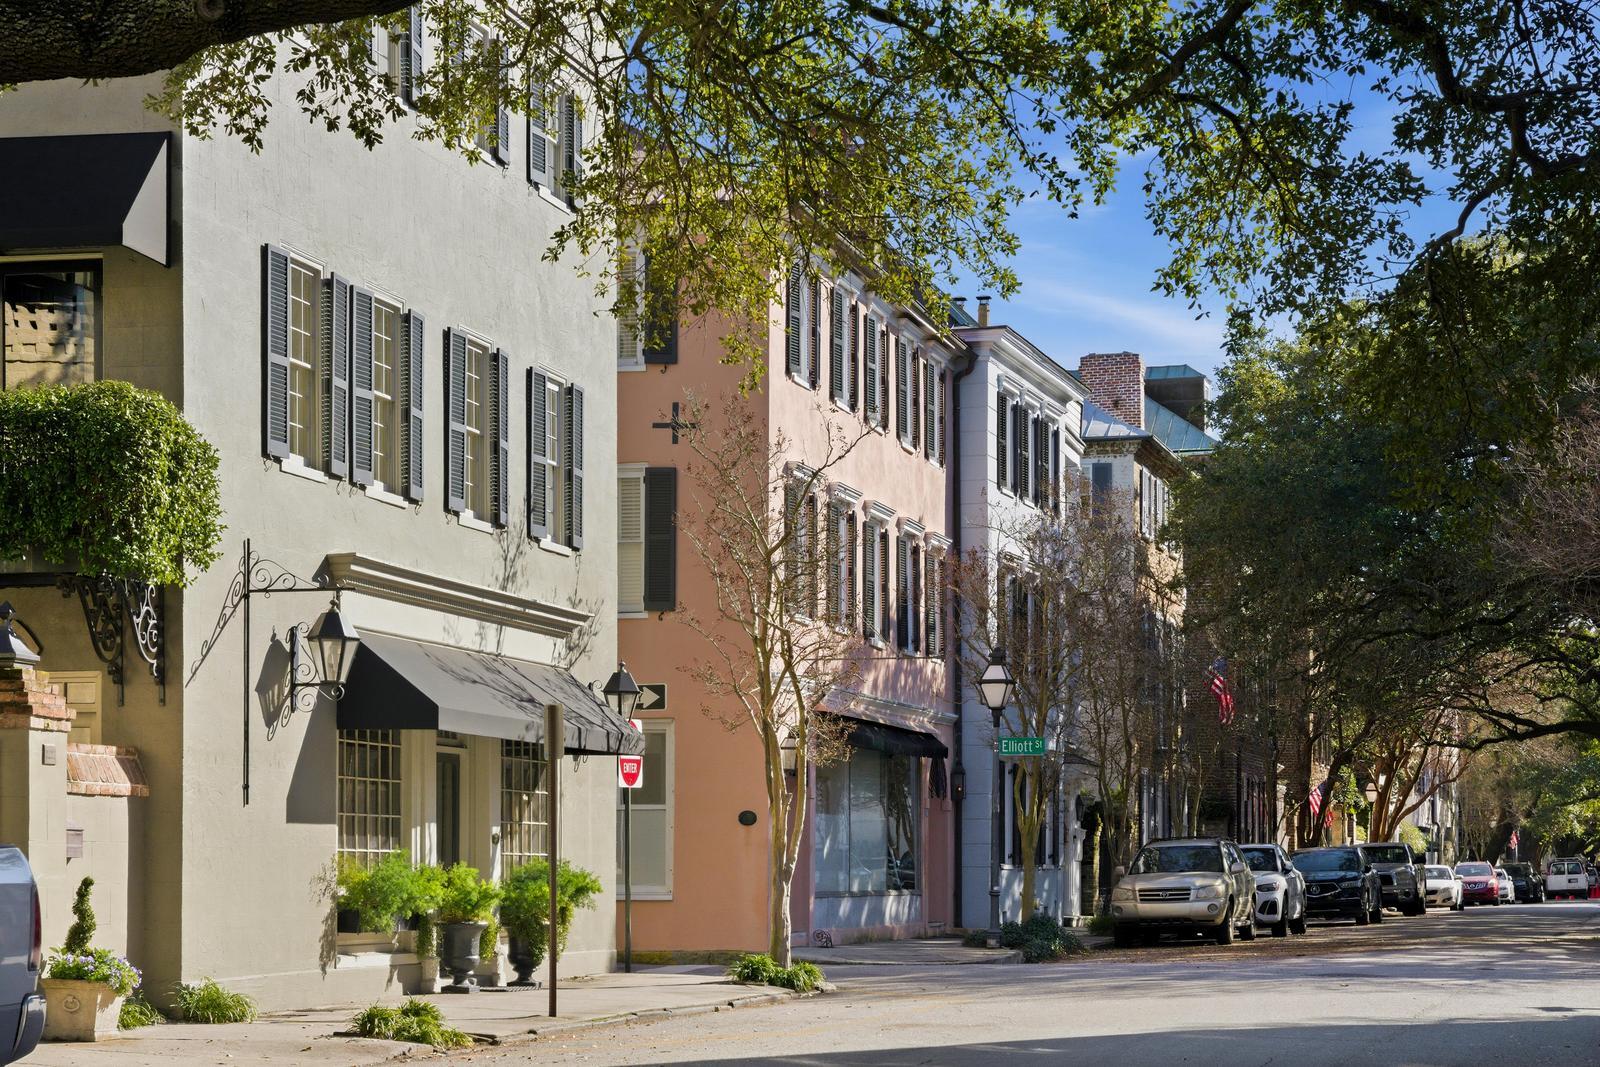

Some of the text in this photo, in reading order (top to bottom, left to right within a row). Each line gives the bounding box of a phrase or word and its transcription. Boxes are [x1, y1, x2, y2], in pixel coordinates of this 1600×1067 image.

[1002, 740, 1042, 752] Elliott St
[623, 762, 638, 773] ENTER
